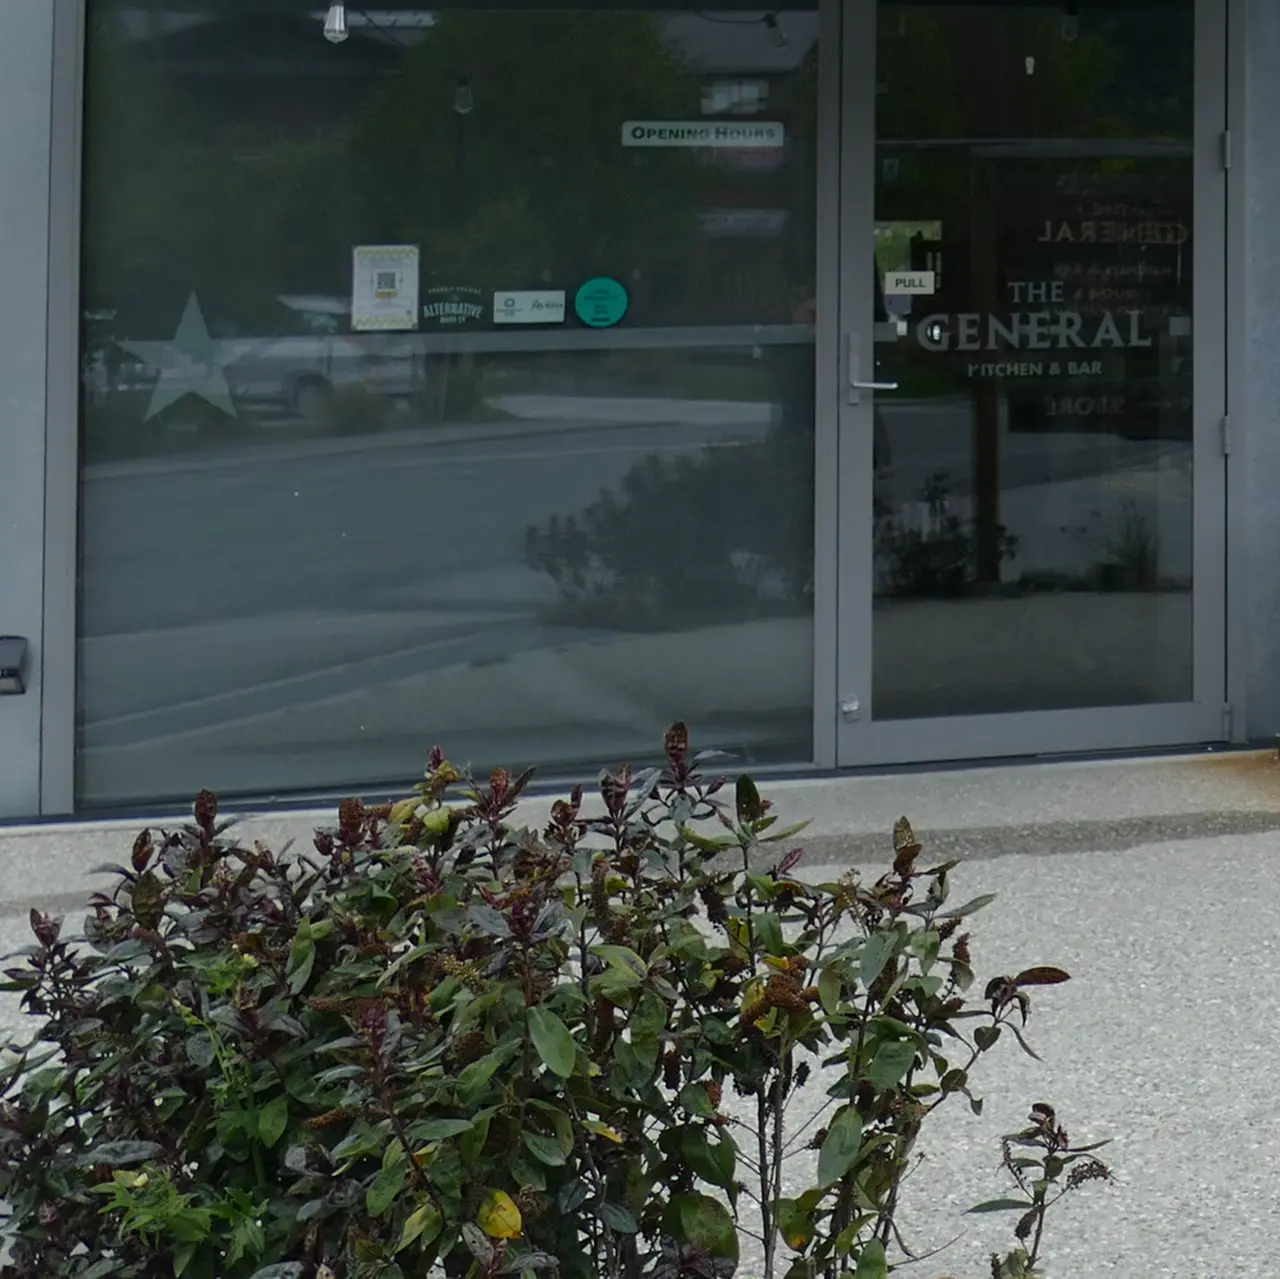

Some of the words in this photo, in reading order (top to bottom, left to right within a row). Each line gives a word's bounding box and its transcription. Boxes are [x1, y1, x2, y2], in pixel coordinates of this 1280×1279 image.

[631, 126, 710, 140] OPENING
[714, 126, 776, 140] HOURS
[895, 277, 927, 288] PULL
[1007, 281, 1064, 304] THE
[917, 310, 1151, 351] GENERAL
[1048, 361, 1061, 376] &
[1068, 360, 1103, 376] BAR
